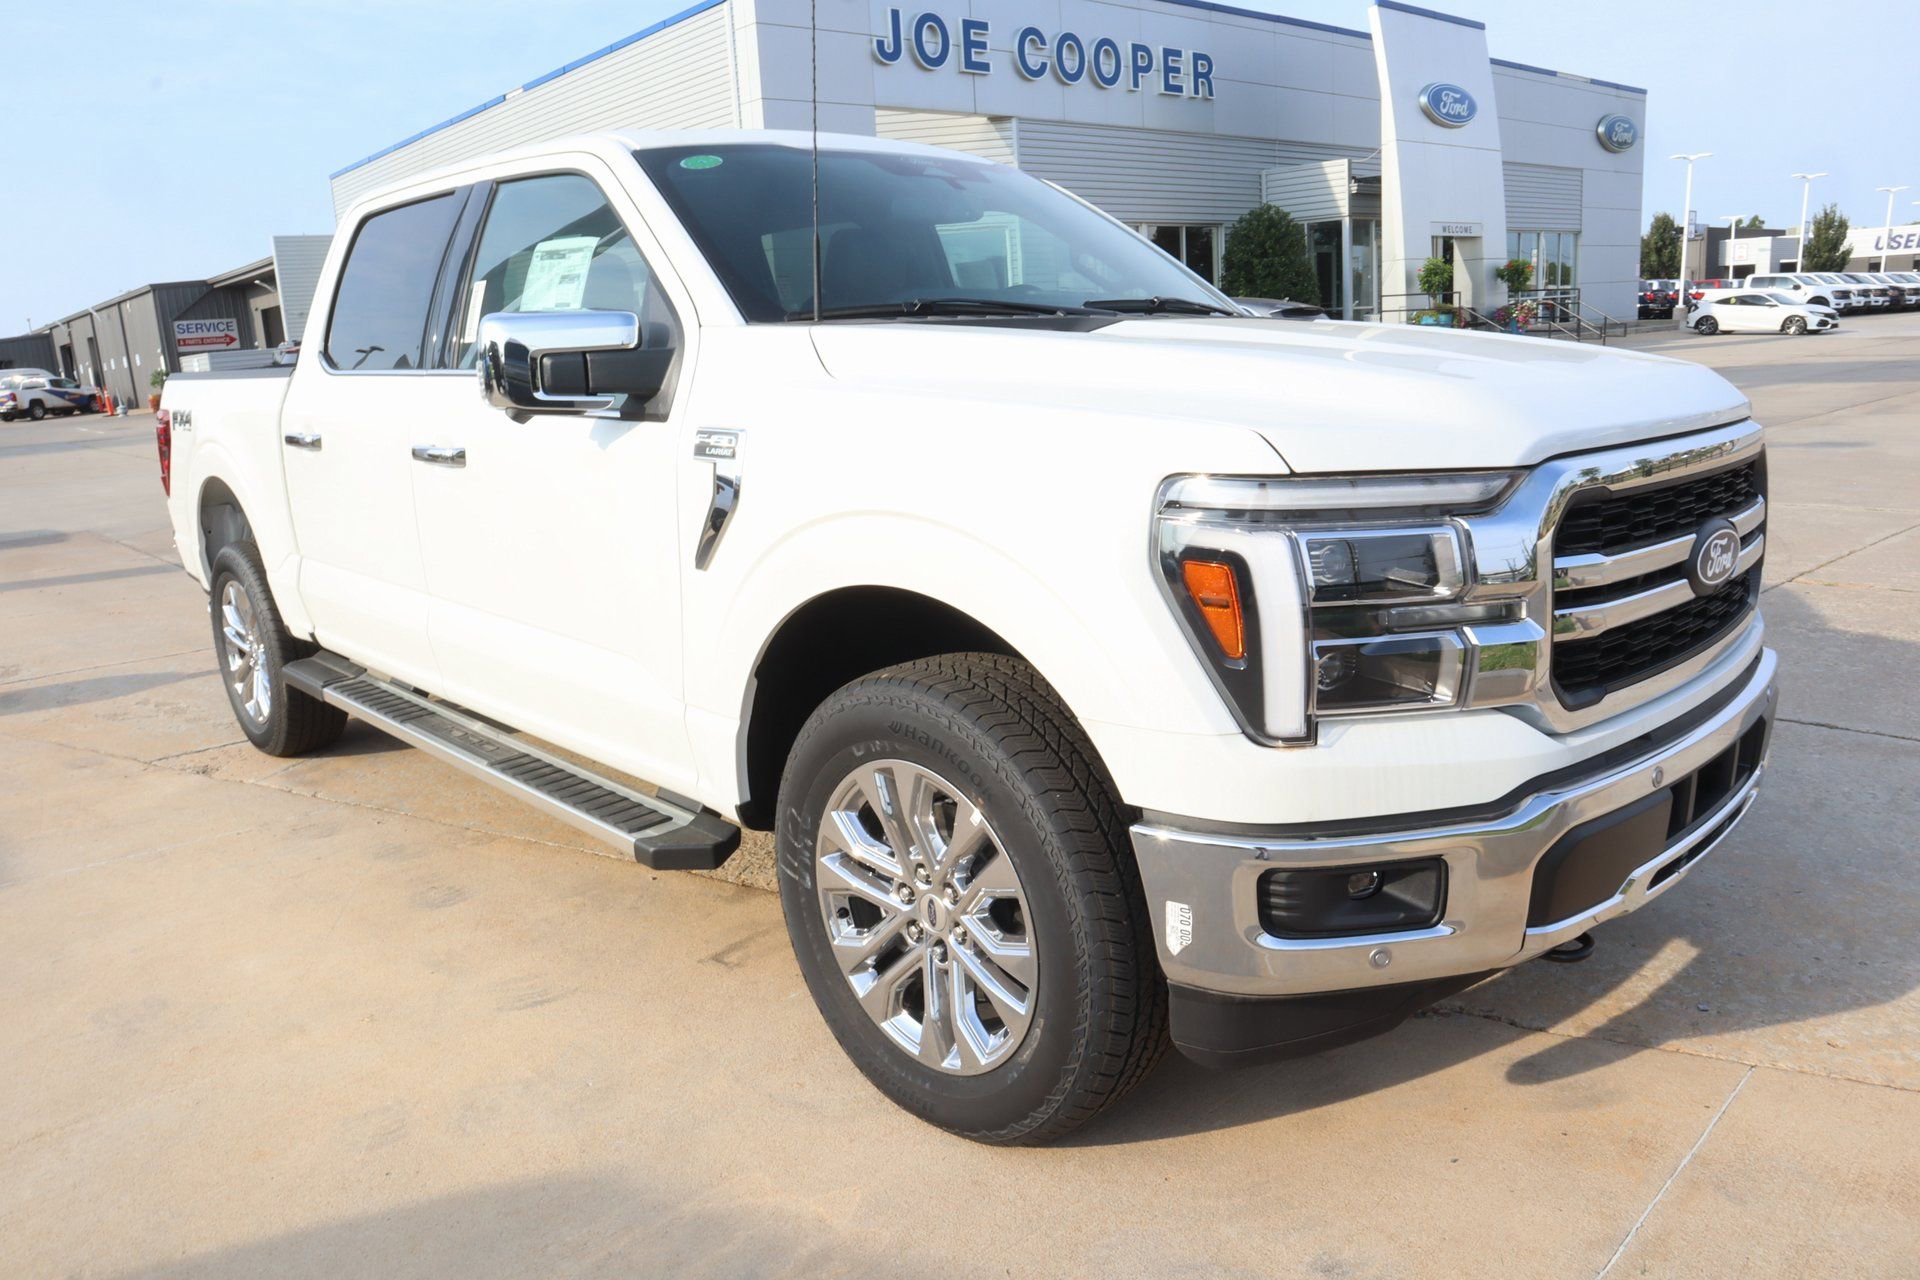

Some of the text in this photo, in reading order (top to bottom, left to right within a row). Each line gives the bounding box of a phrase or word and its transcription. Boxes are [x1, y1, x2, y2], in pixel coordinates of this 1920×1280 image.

[874, 7, 1215, 99] JOE COOPER
[1440, 90, 1469, 116] Ford
[1611, 121, 1634, 144] Ford
[1442, 224, 1473, 235] WELCOME
[1874, 232, 1920, 251] USE
[176, 321, 234, 334] SERVICE
[203, 336, 231, 344] ENTRANCE
[705, 447, 733, 456] LARIAT
[1707, 537, 1735, 578] Ford
[1180, 907, 1191, 926] 070
